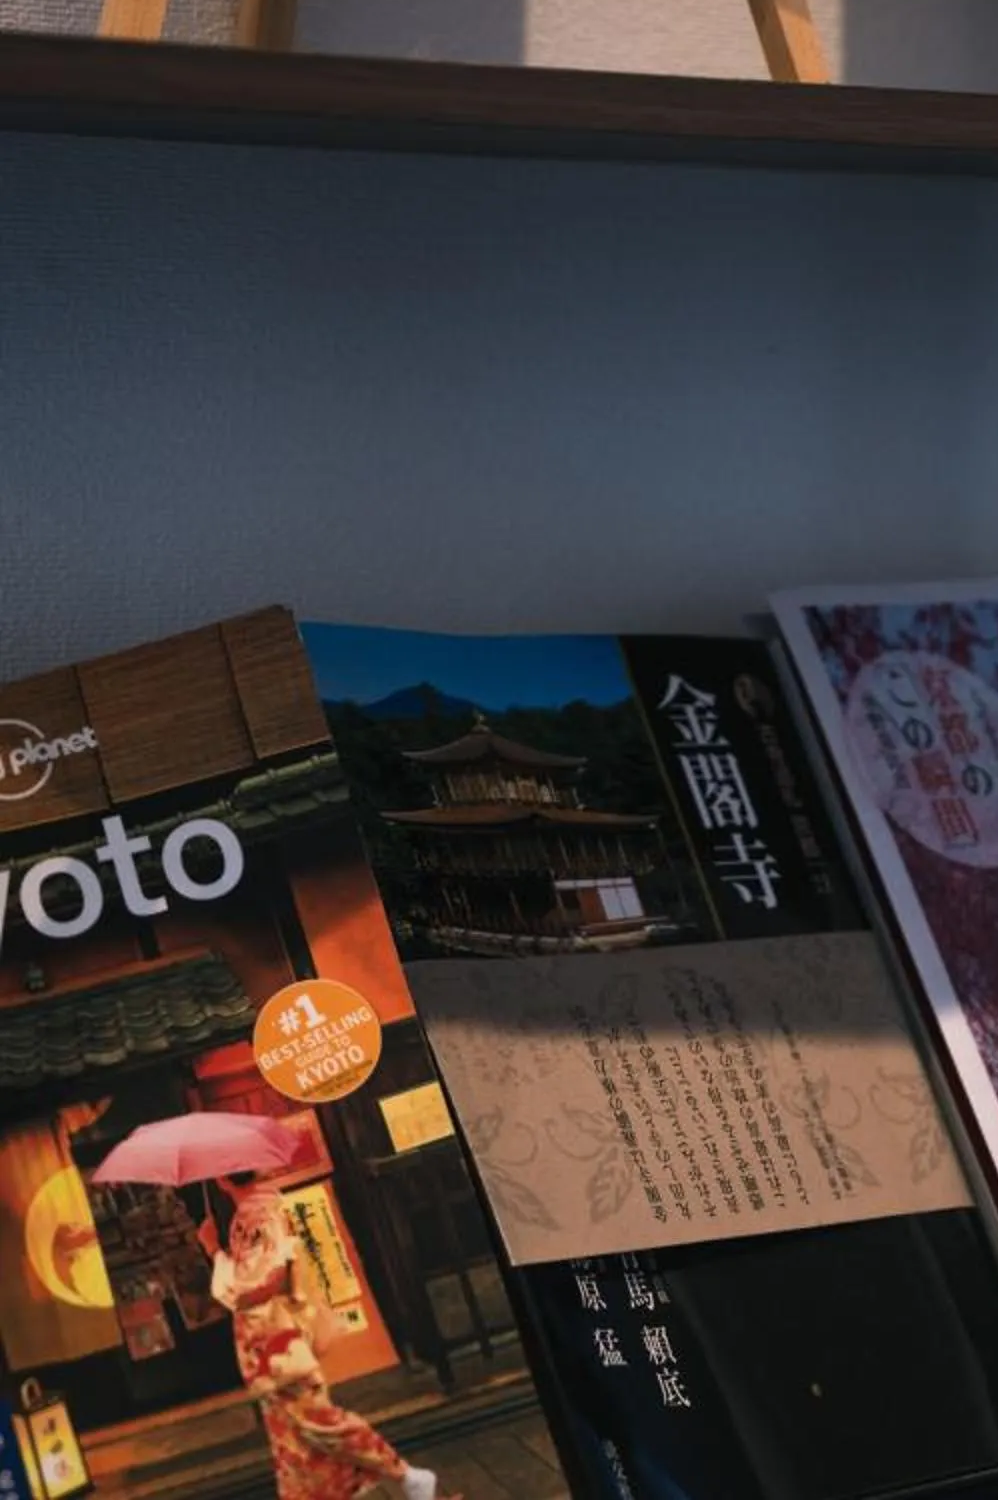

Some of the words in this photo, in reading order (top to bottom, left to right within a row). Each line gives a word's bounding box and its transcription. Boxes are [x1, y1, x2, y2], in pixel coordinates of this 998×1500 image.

[9, 726, 97, 776] planet
[658, 675, 783, 909] 金閣寺
[260, 1006, 372, 1071] BEST-SELLING
[279, 994, 327, 1036] #1
[296, 1044, 364, 1090] KYOTO
